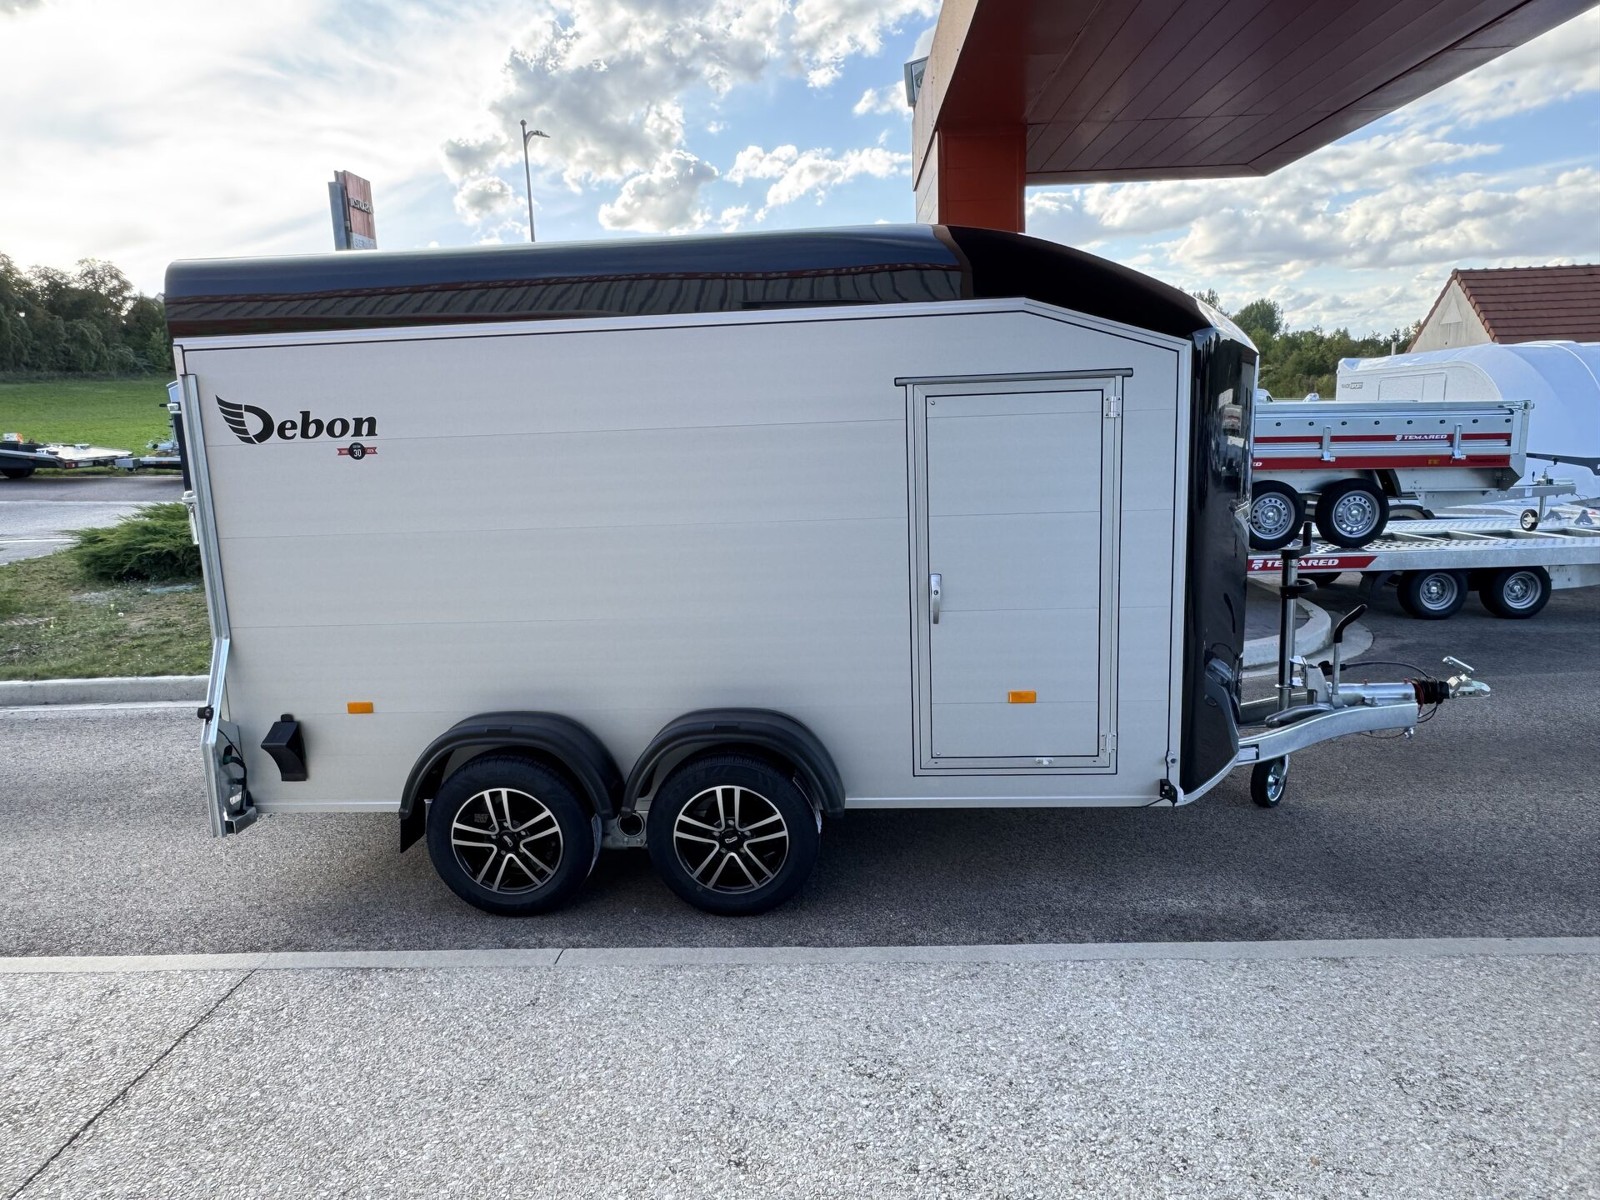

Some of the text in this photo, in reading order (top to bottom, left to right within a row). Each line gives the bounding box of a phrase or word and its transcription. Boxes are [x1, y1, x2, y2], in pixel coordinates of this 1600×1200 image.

[215, 394, 378, 444] Debon
[353, 449, 362, 457] 30
[1266, 559, 1339, 567] TEARED
